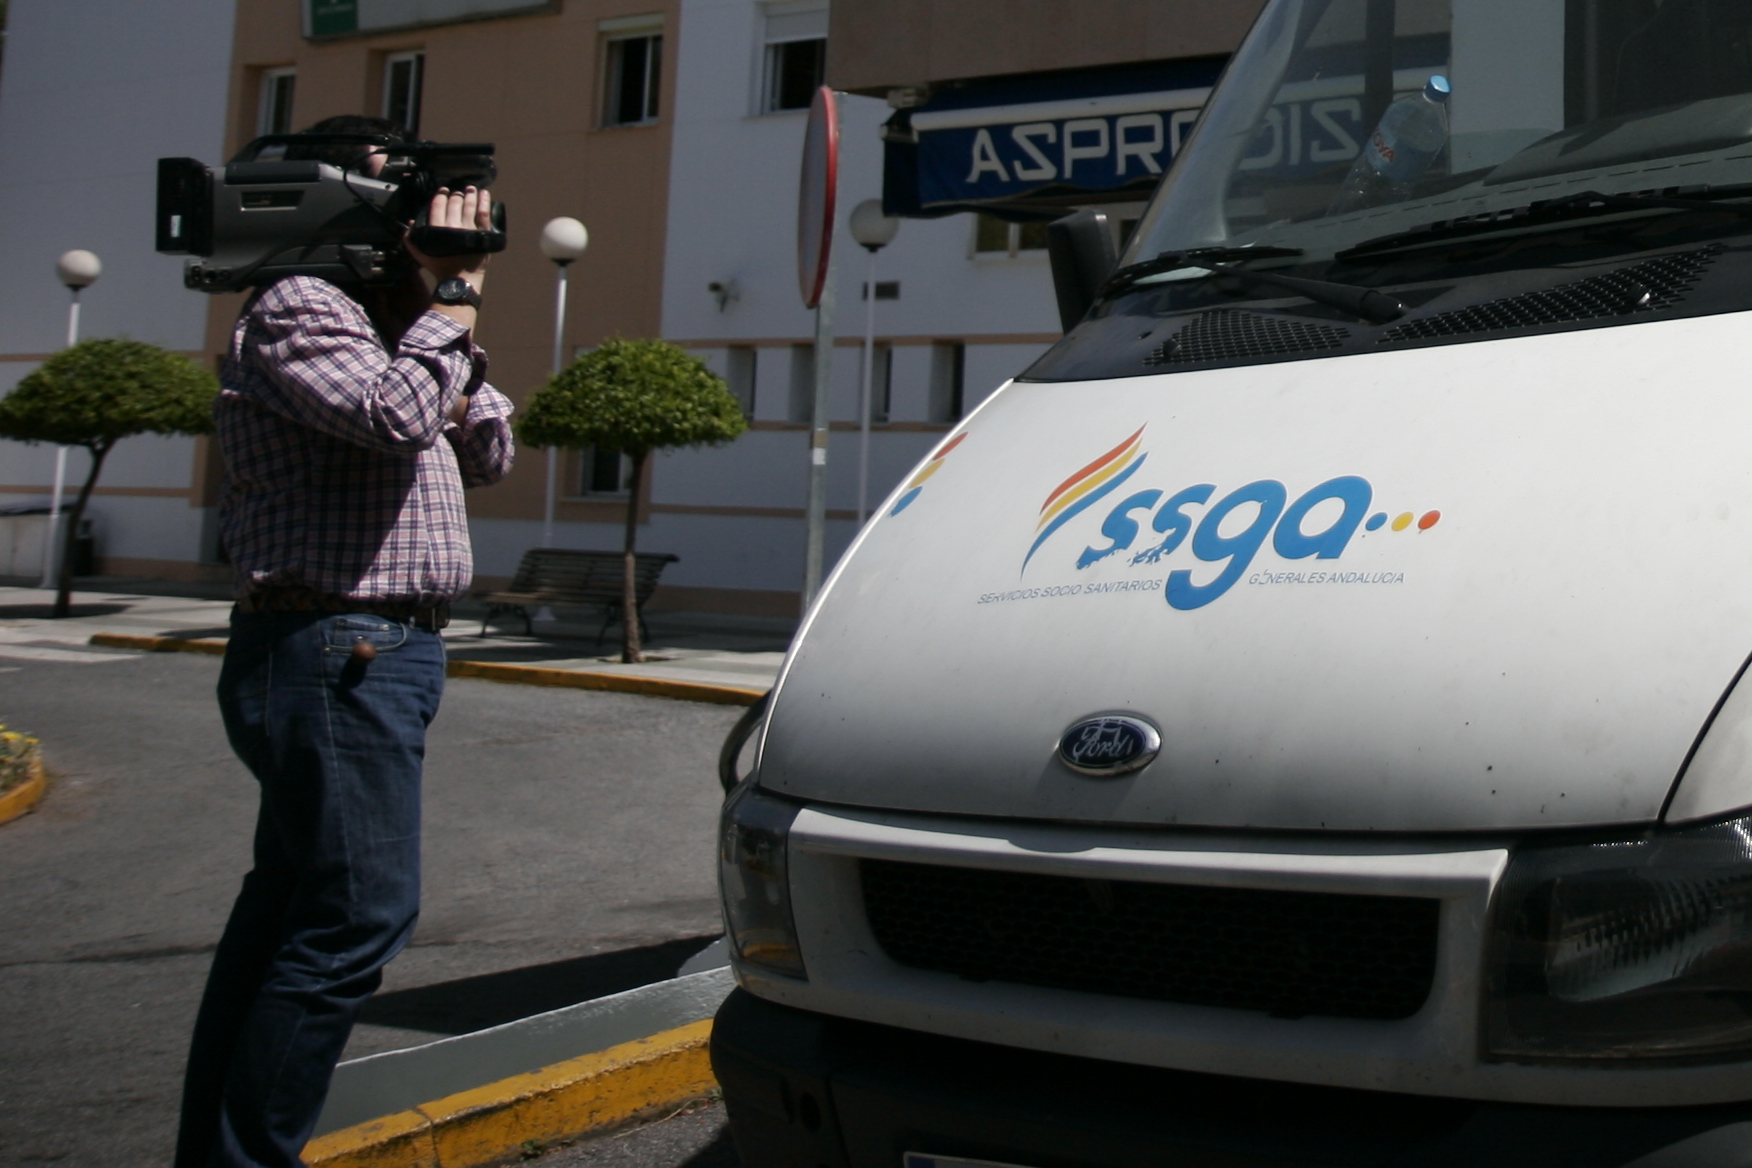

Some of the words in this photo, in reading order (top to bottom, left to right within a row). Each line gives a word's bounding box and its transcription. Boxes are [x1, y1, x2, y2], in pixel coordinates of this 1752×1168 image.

[1076, 475, 1373, 610] ssga
[977, 588, 1040, 604] SERVICIOS
[1041, 584, 1082, 598] SOCIO
[1083, 579, 1163, 595] SANITARIOS
[1326, 572, 1405, 584] ANDALUCIA
